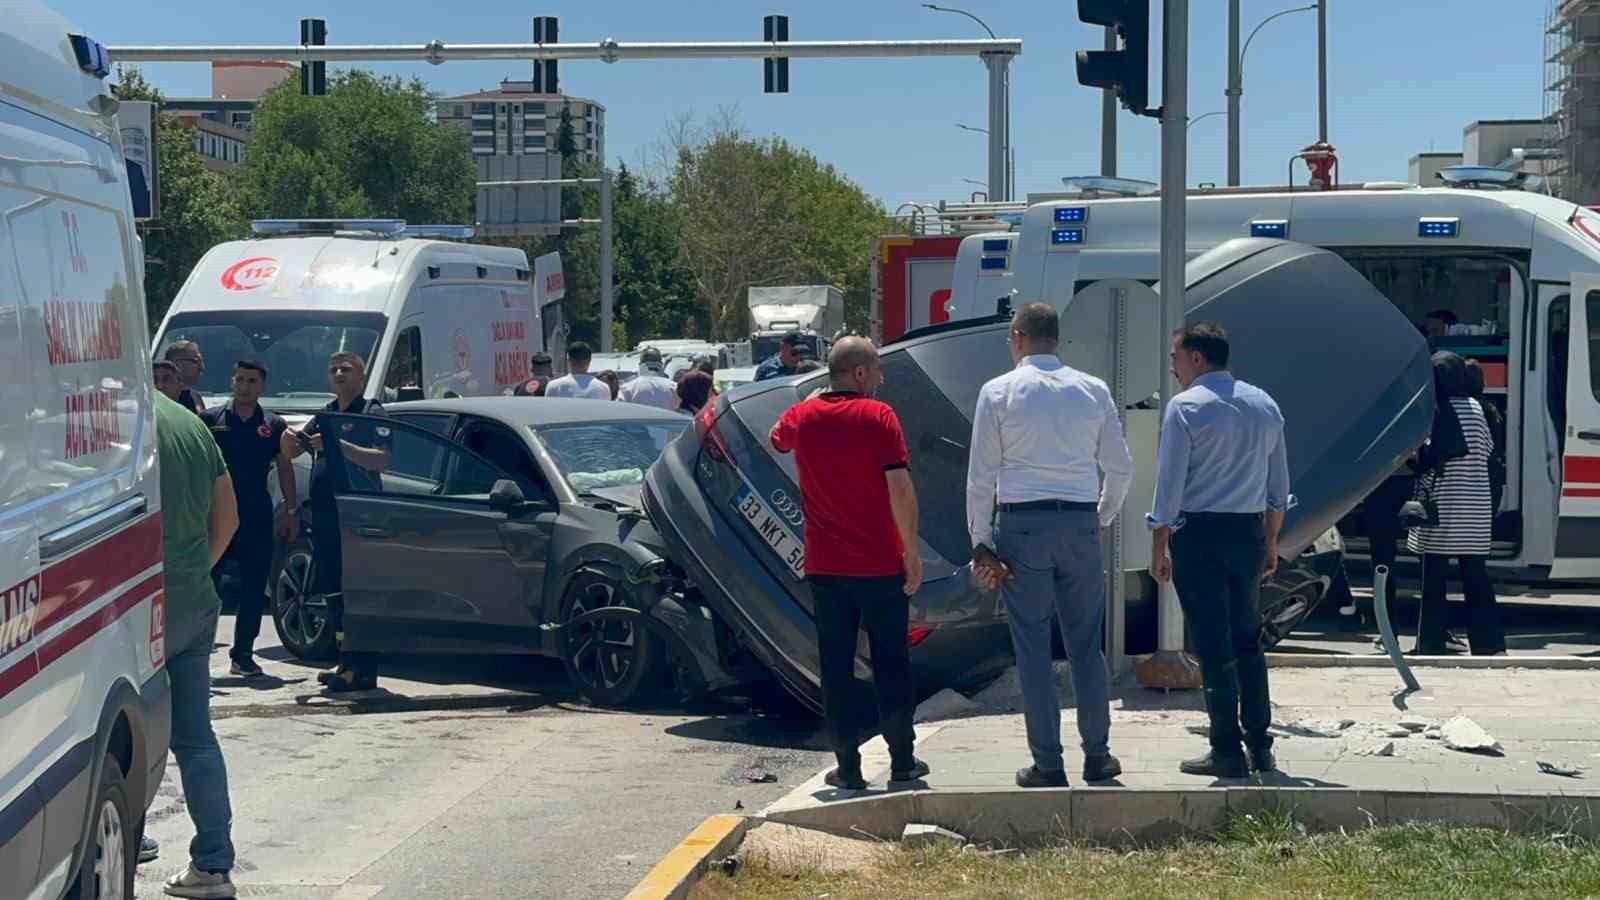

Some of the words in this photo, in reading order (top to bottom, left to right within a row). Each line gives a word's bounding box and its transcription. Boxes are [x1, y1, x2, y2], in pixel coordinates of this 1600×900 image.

[245, 267, 277, 279] 112
[742, 496, 761, 519] 33
[761, 517, 788, 547] NKT
